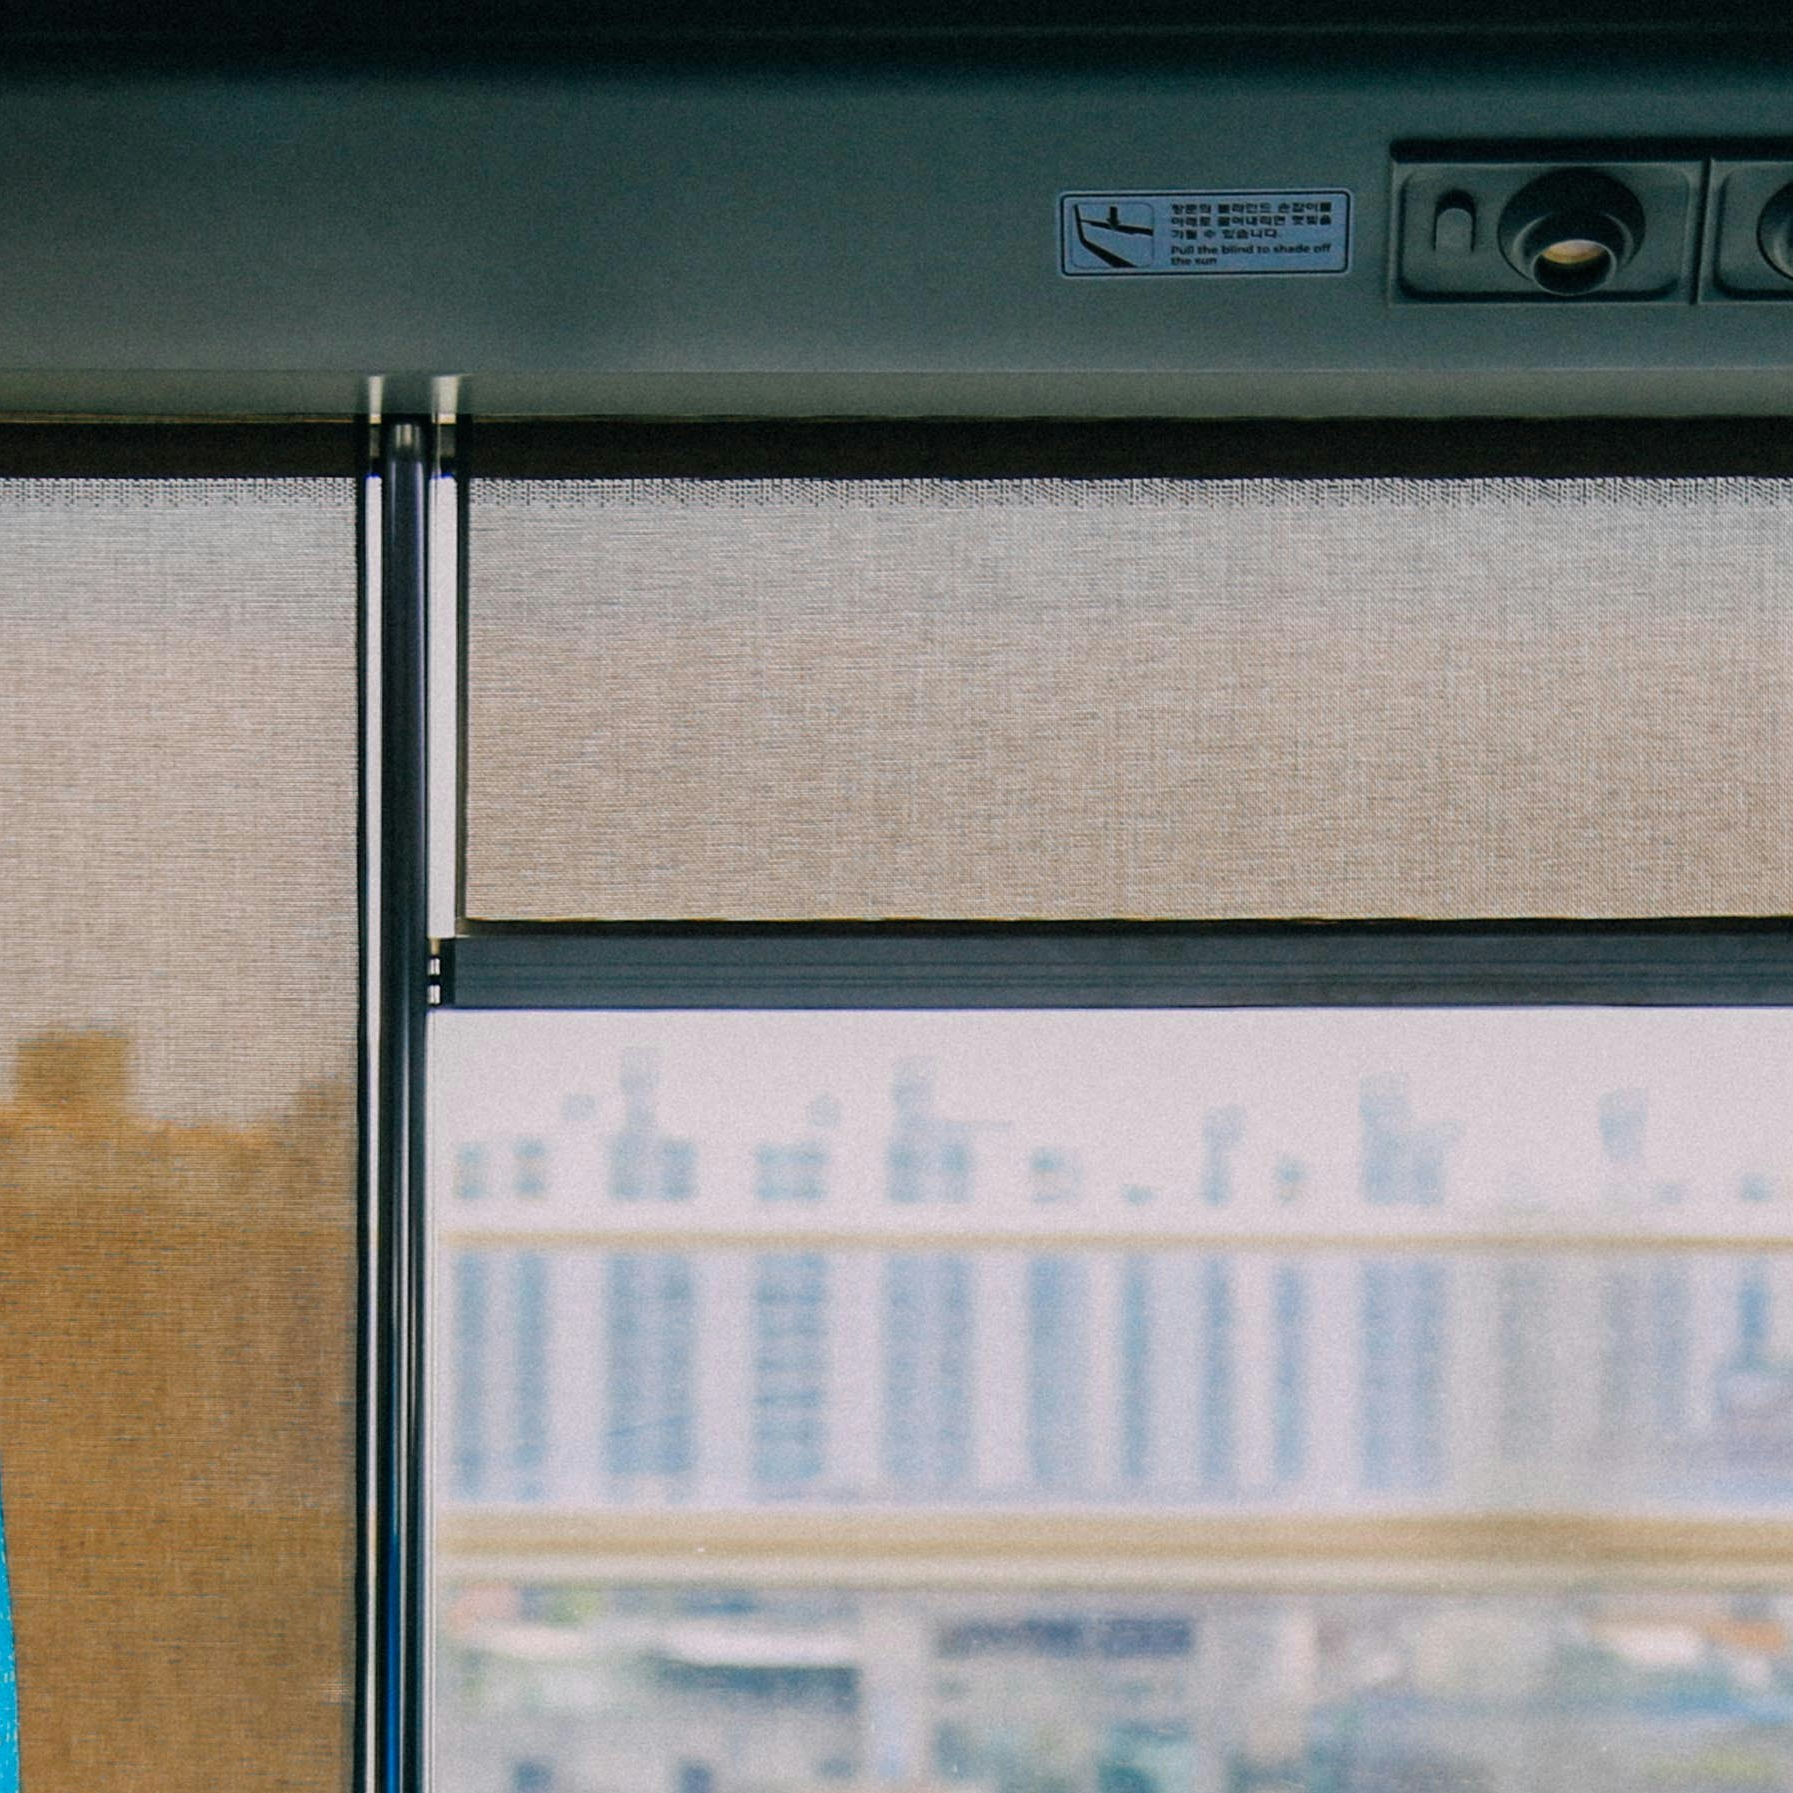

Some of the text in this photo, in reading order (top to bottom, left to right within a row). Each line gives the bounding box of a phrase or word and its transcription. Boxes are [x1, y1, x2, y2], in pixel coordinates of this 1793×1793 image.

[1203, 229, 1216, 239] 수
[1170, 243, 1331, 255] Pull the blind to shade off
[1170, 257, 1192, 266] the
